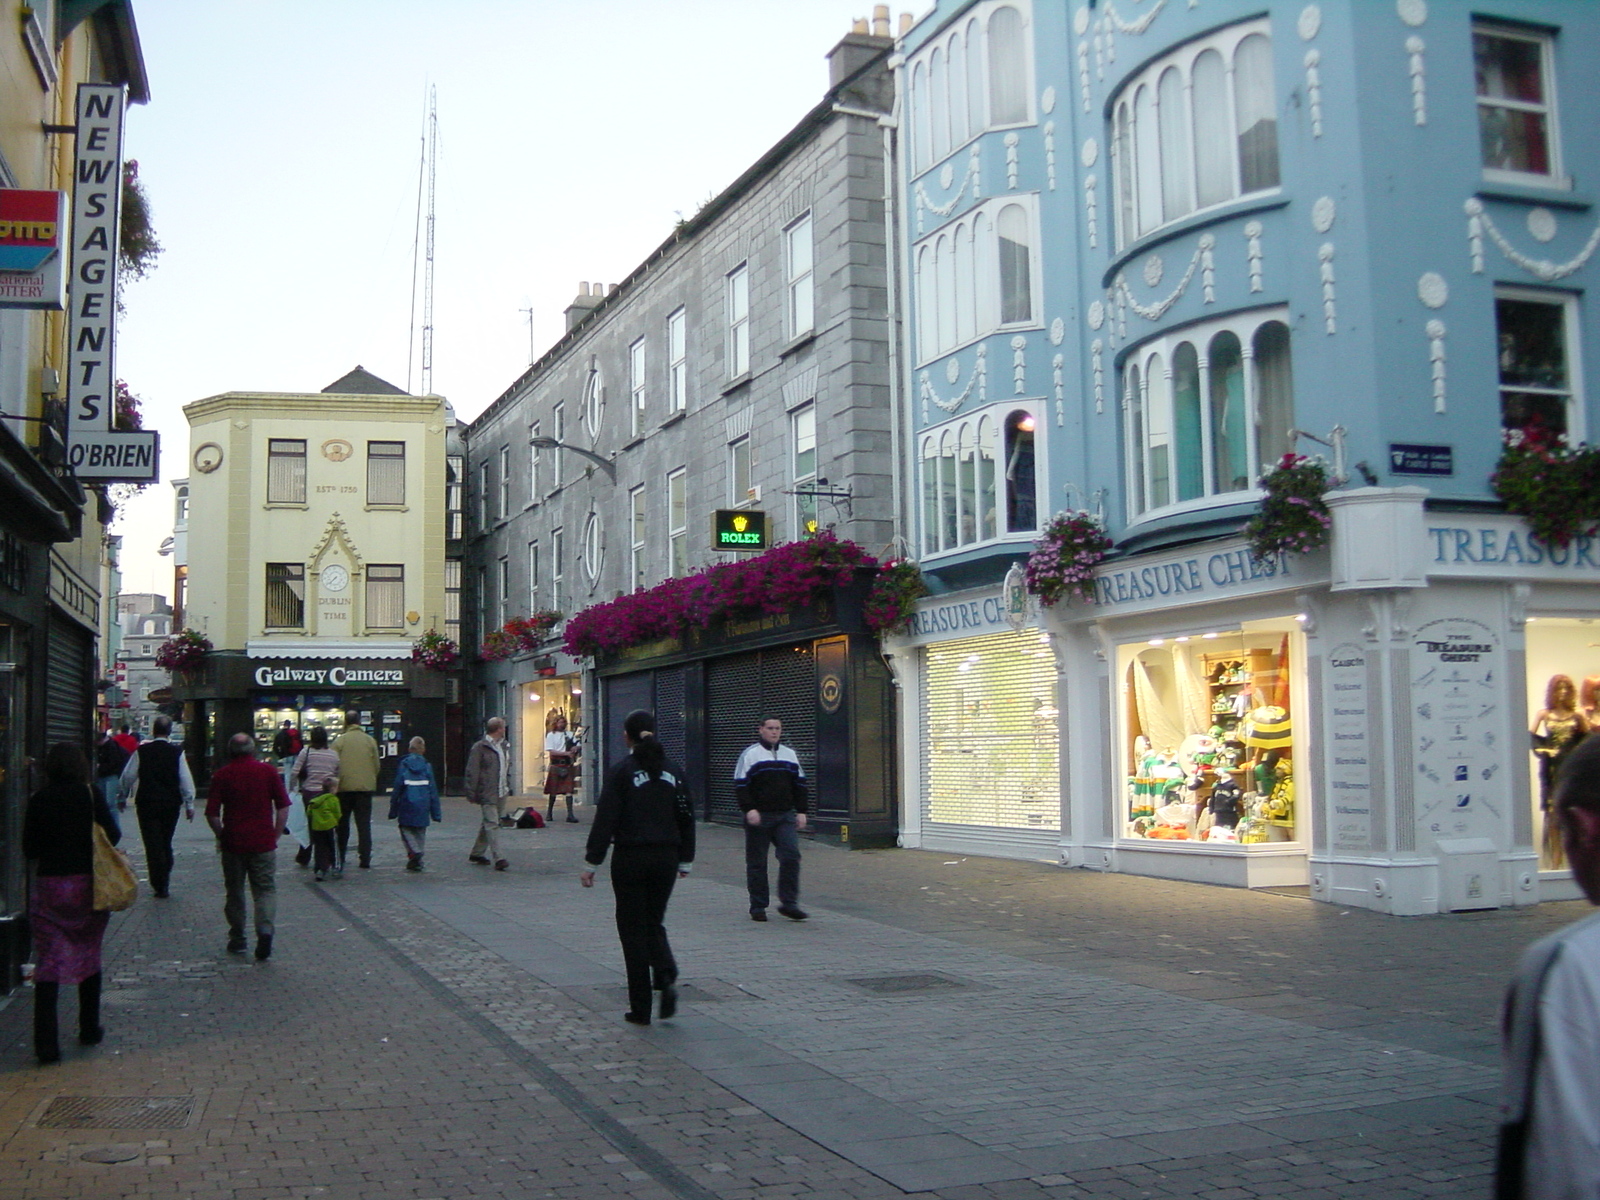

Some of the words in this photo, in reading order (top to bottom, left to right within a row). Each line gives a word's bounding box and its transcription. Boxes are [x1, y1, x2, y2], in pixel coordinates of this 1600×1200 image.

[77, 94, 114, 423] NEWSAGENTS
[69, 443, 152, 469] O'BRIEN
[720, 533, 760, 544] ROLEX
[1428, 527, 1600, 566] TREASUR
[1416, 641, 1492, 653] TREASURE
[1440, 653, 1480, 663] CHEST
[255, 666, 327, 686] Galway
[329, 667, 403, 686] Camera
